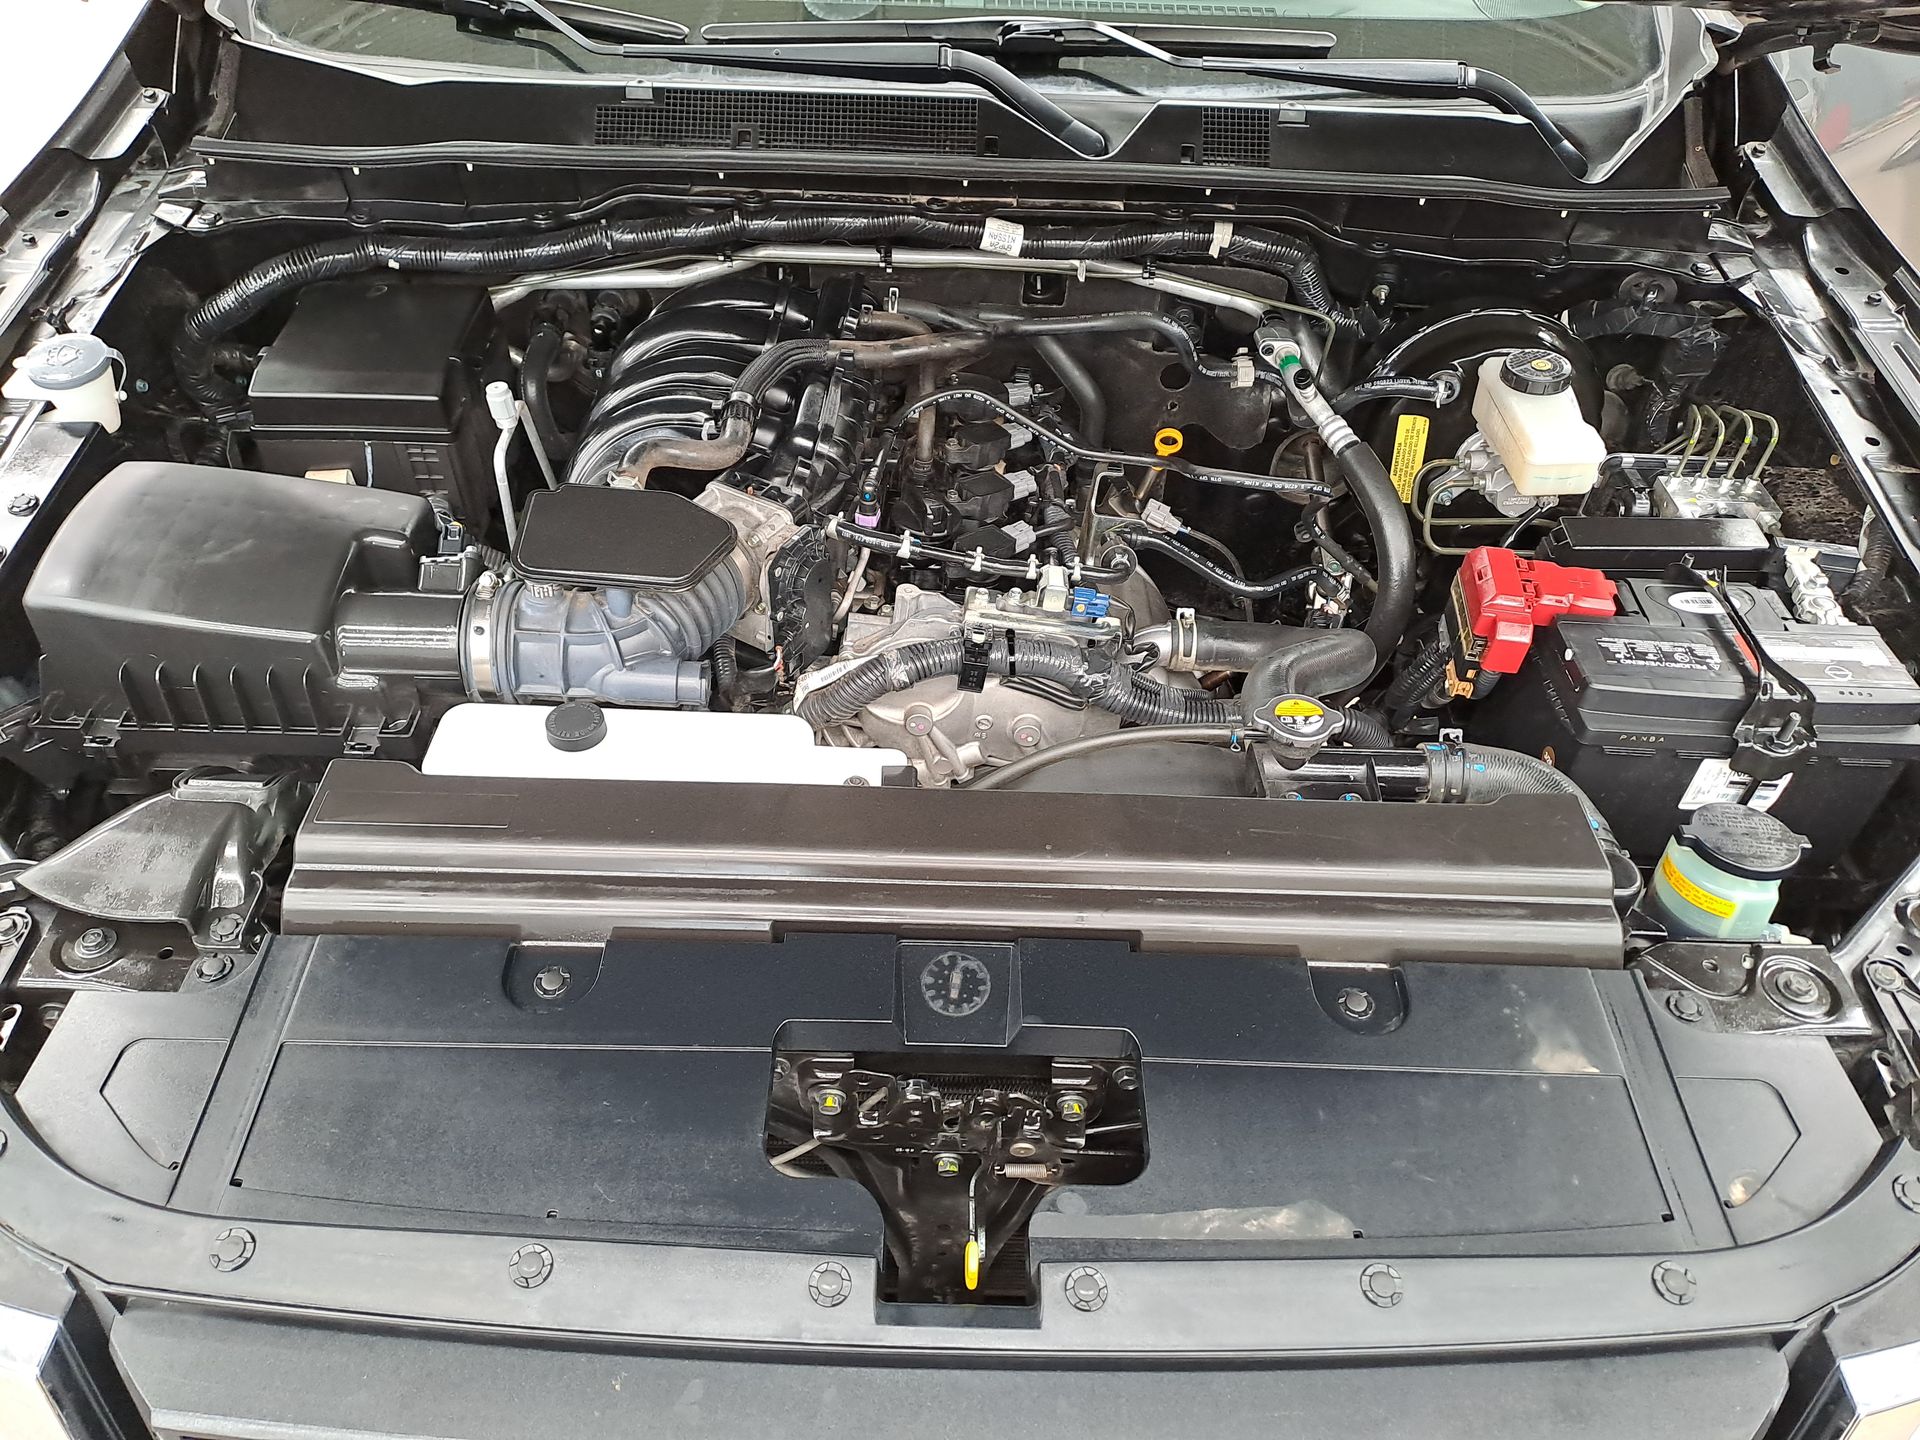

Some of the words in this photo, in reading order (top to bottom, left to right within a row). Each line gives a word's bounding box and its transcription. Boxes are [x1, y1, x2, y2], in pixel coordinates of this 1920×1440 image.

[988, 232, 1017, 244] NISSAN
[1392, 442, 1403, 477] ADVERTENCIA
[1399, 448, 1407, 467] LLENADO
[1620, 659, 1708, 670] PELIGRO/VENENO
